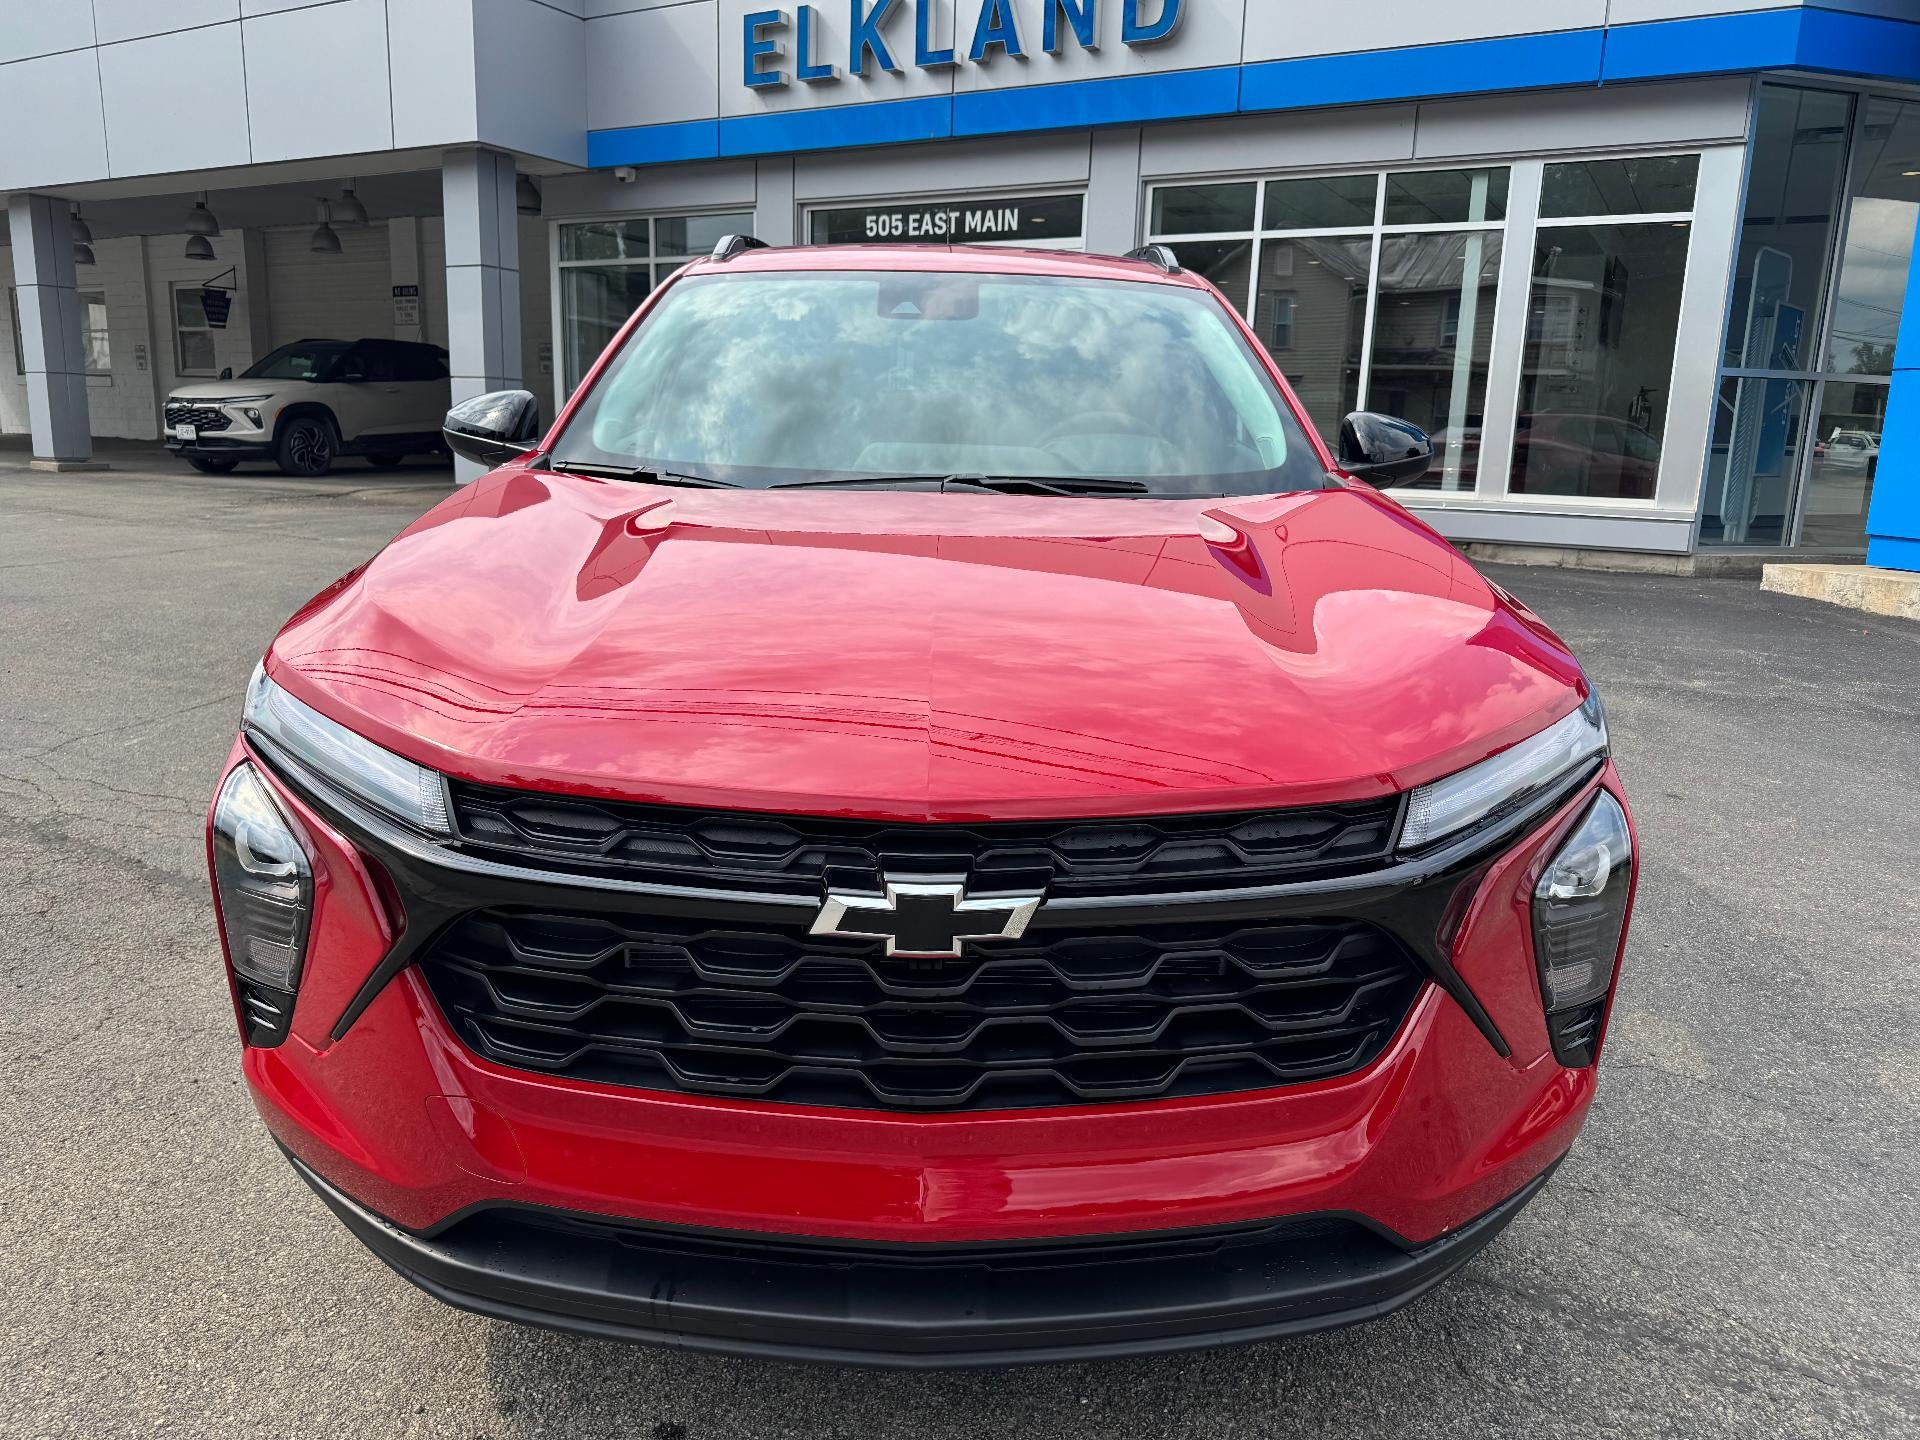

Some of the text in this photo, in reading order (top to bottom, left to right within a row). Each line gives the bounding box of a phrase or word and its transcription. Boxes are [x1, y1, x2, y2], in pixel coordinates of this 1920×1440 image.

[744, 0, 1184, 89] ELKLAND
[865, 208, 1019, 237] 505 EAST MAIN
